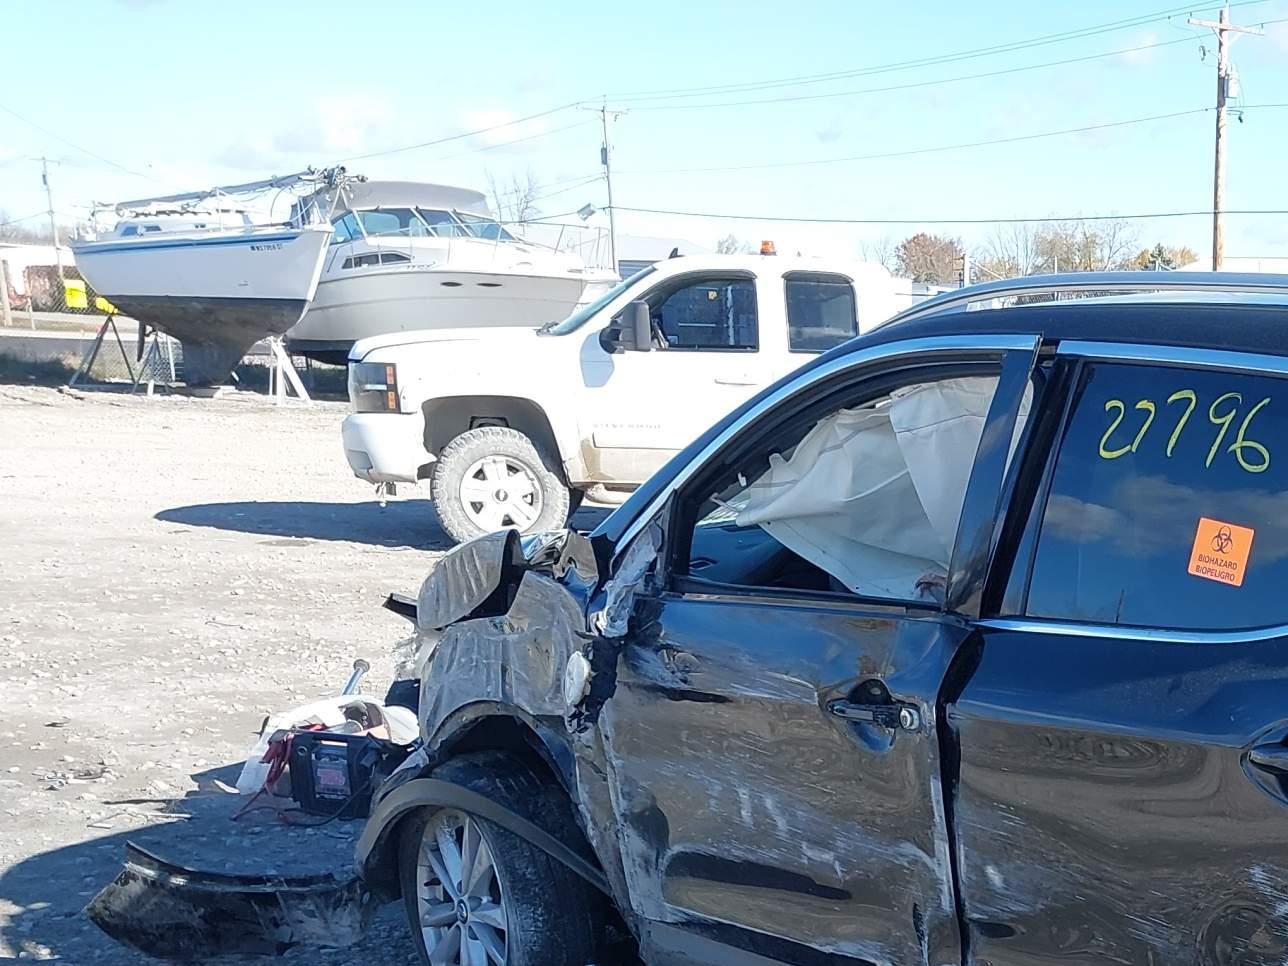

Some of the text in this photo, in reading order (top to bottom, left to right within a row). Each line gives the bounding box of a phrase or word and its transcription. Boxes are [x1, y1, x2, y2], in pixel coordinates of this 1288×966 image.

[1099, 389, 1272, 473] 27796
[1197, 553, 1238, 571] BIOHAZARD
[1195, 564, 1236, 582] BIOPELIGRO
